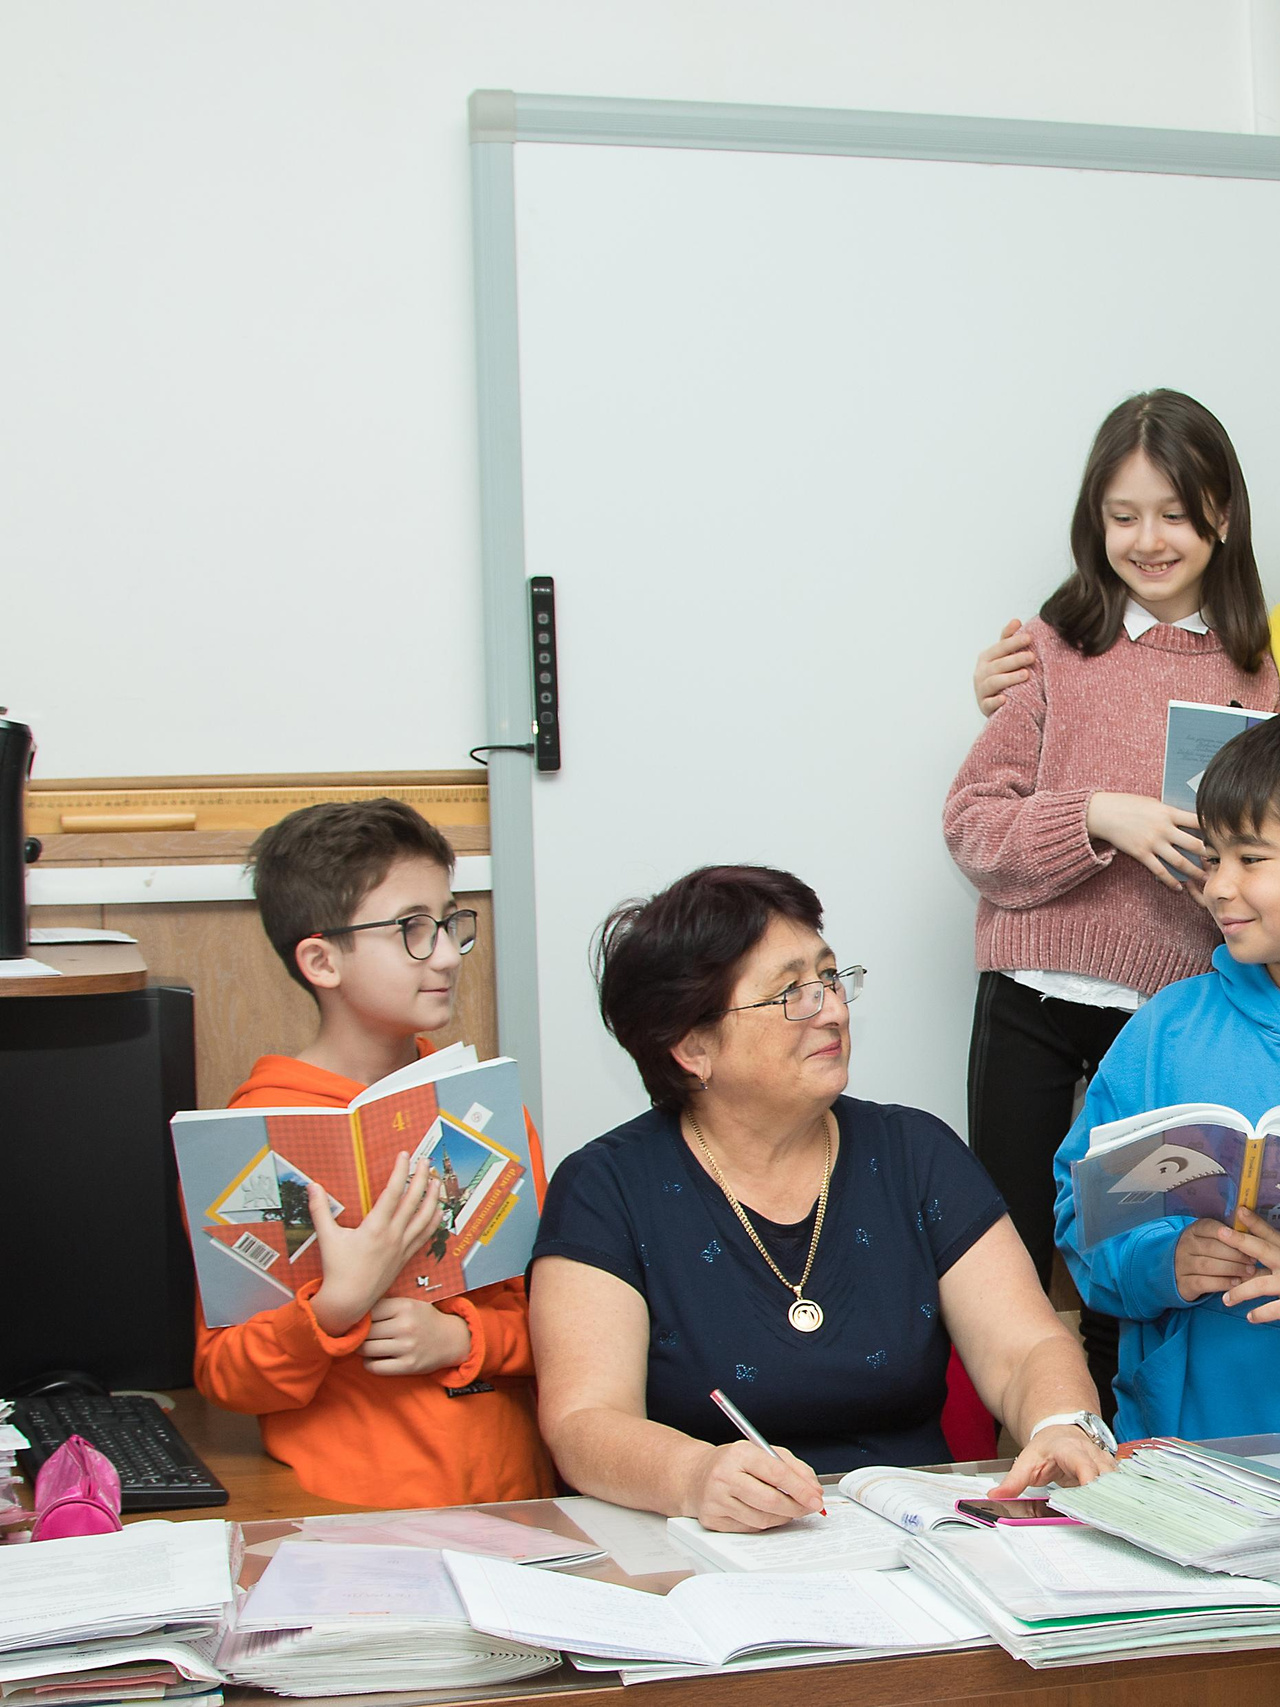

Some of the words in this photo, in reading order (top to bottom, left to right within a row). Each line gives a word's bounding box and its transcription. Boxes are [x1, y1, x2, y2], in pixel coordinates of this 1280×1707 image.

[392, 1110, 406, 1132] 4
[452, 1188, 502, 1257] Окружающий
[499, 1166, 517, 1191] мир
